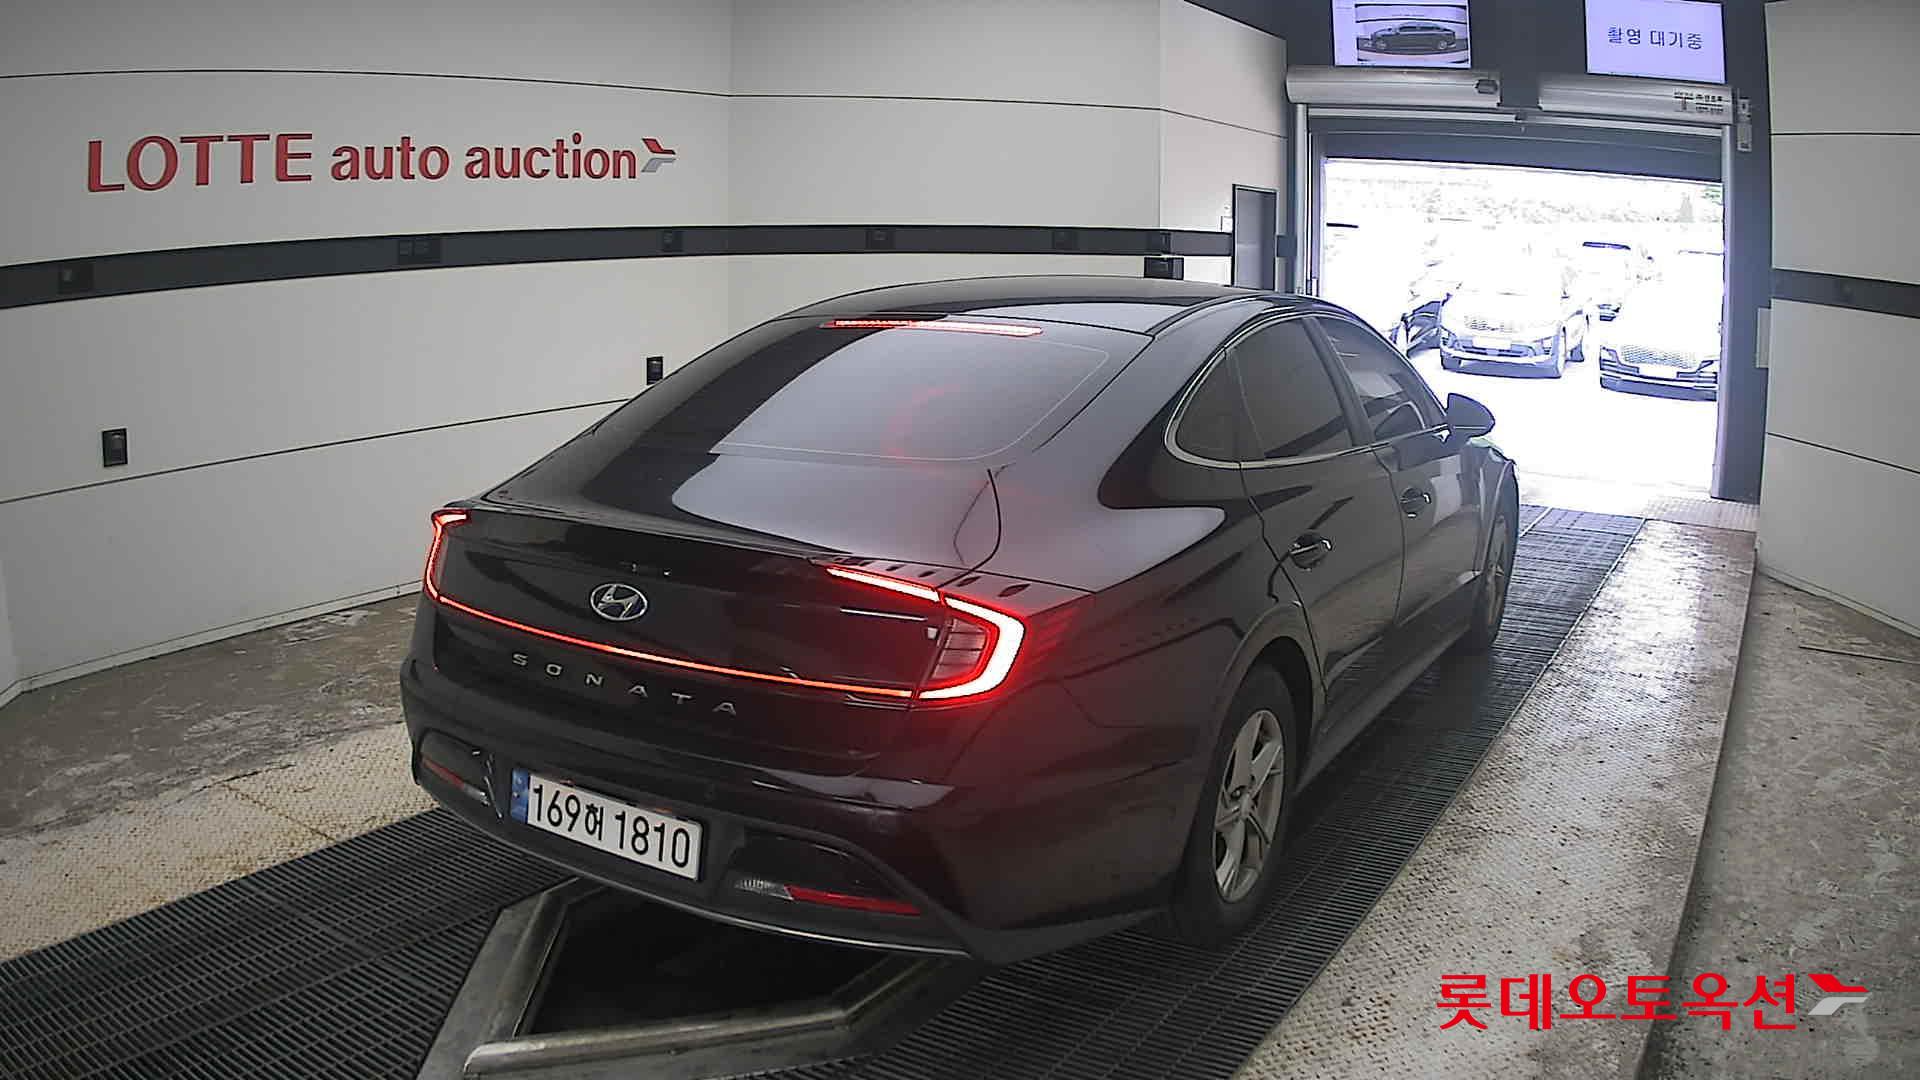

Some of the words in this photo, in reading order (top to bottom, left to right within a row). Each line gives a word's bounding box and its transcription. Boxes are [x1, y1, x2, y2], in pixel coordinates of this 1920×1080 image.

[1607, 26, 1642, 45] 촬영
[1650, 29, 1703, 50] 대기중
[87, 133, 313, 192] LOTTE
[330, 136, 450, 181] auto
[464, 132, 637, 180] auction
[512, 653, 736, 714] SONATA
[533, 784, 604, 841] 169허
[615, 811, 690, 868] 1810
